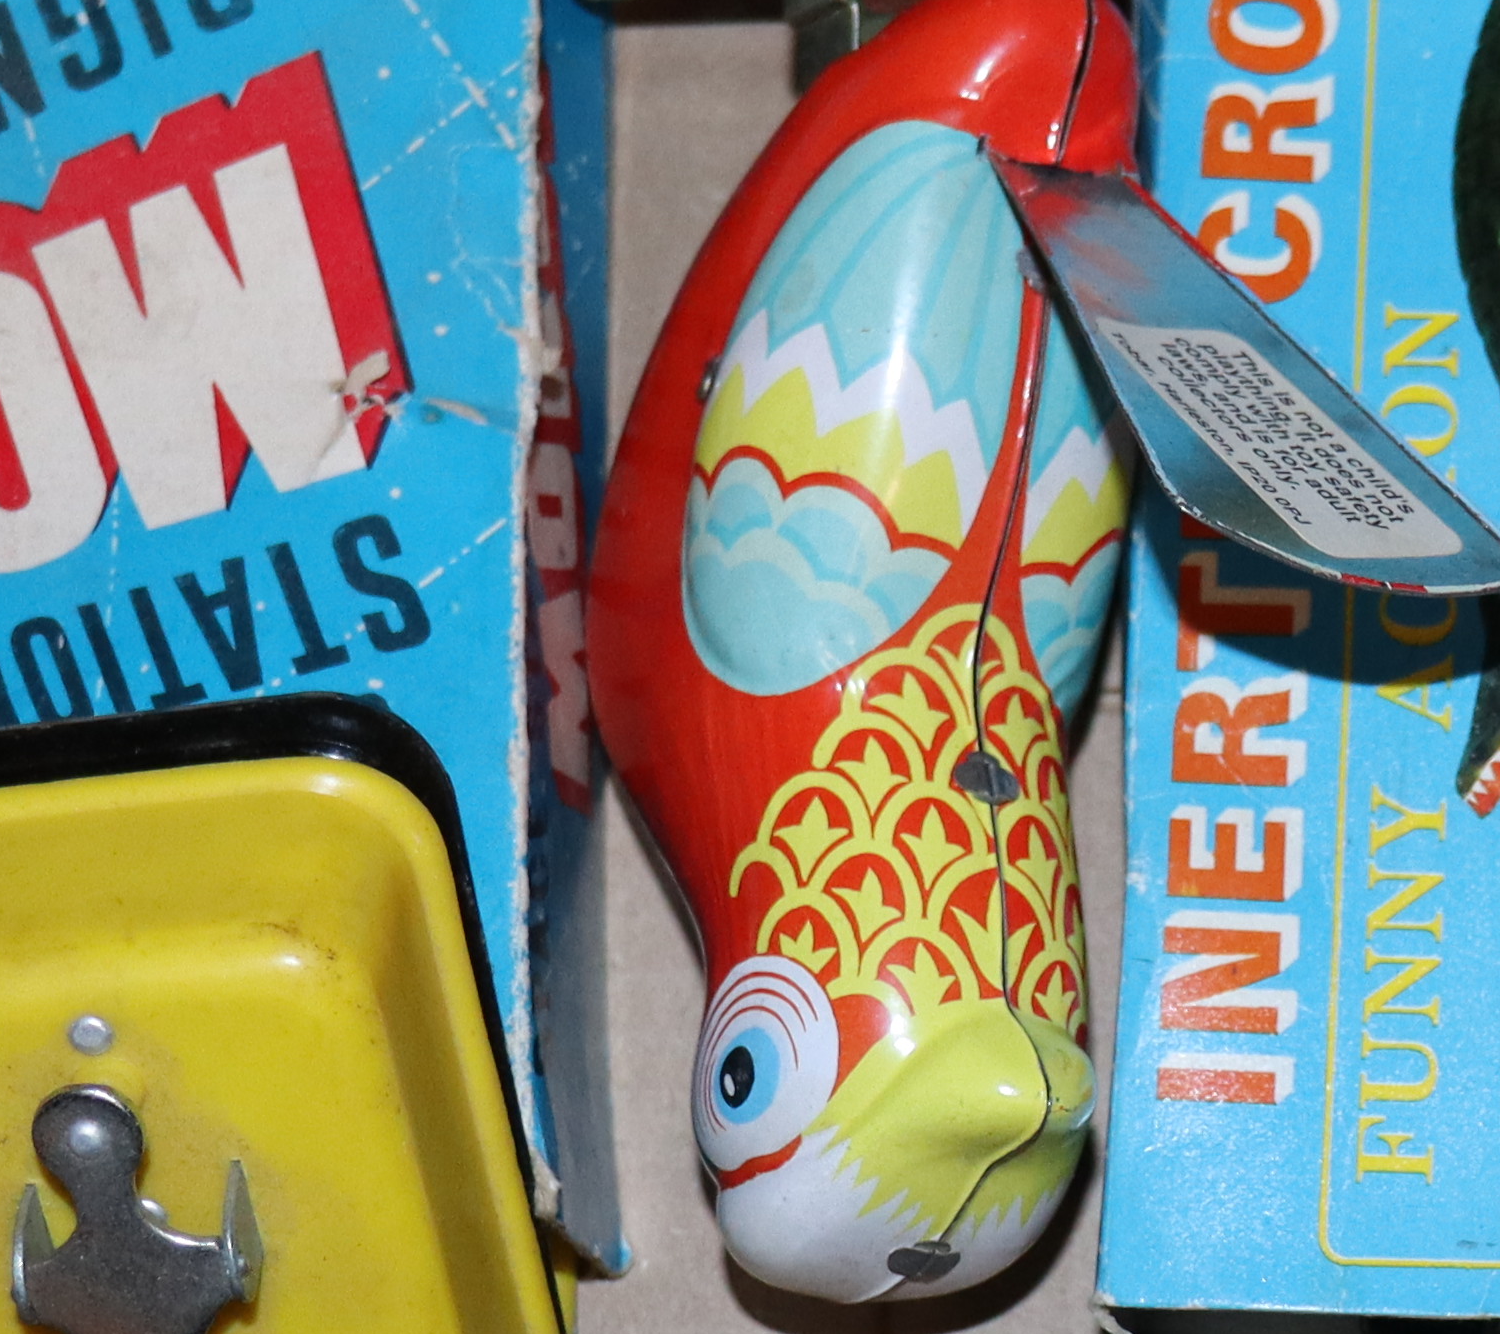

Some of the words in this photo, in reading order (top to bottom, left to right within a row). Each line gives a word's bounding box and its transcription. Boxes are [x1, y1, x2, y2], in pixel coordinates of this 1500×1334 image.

[1158, 356, 1252, 442] collectors
[1253, 448, 1300, 490] only.
[1175, 337, 1247, 400] comply
[1247, 404, 1290, 440] with
[1290, 445, 1326, 473] toy
[1325, 477, 1389, 530] safety
[1197, 344, 1292, 426] plaything.
[1295, 431, 1317, 443] It
[1314, 448, 1365, 489] does
[1366, 495, 1404, 523] not
[1213, 391, 1258, 425] and
[1252, 430, 1274, 444] is
[1274, 449, 1308, 474] for
[1306, 479, 1361, 523] adult
[1233, 351, 1273, 387] This
[1274, 391, 1296, 407] is
[1294, 412, 1334, 439] not
[1330, 443, 1346, 453] a
[1347, 458, 1414, 515] child's
[1237, 461, 1278, 494] IP20
[1376, 304, 1462, 730] ACON
[1156, 508, 1312, 1105] INERT
[1356, 781, 1451, 1184] FUNNY
